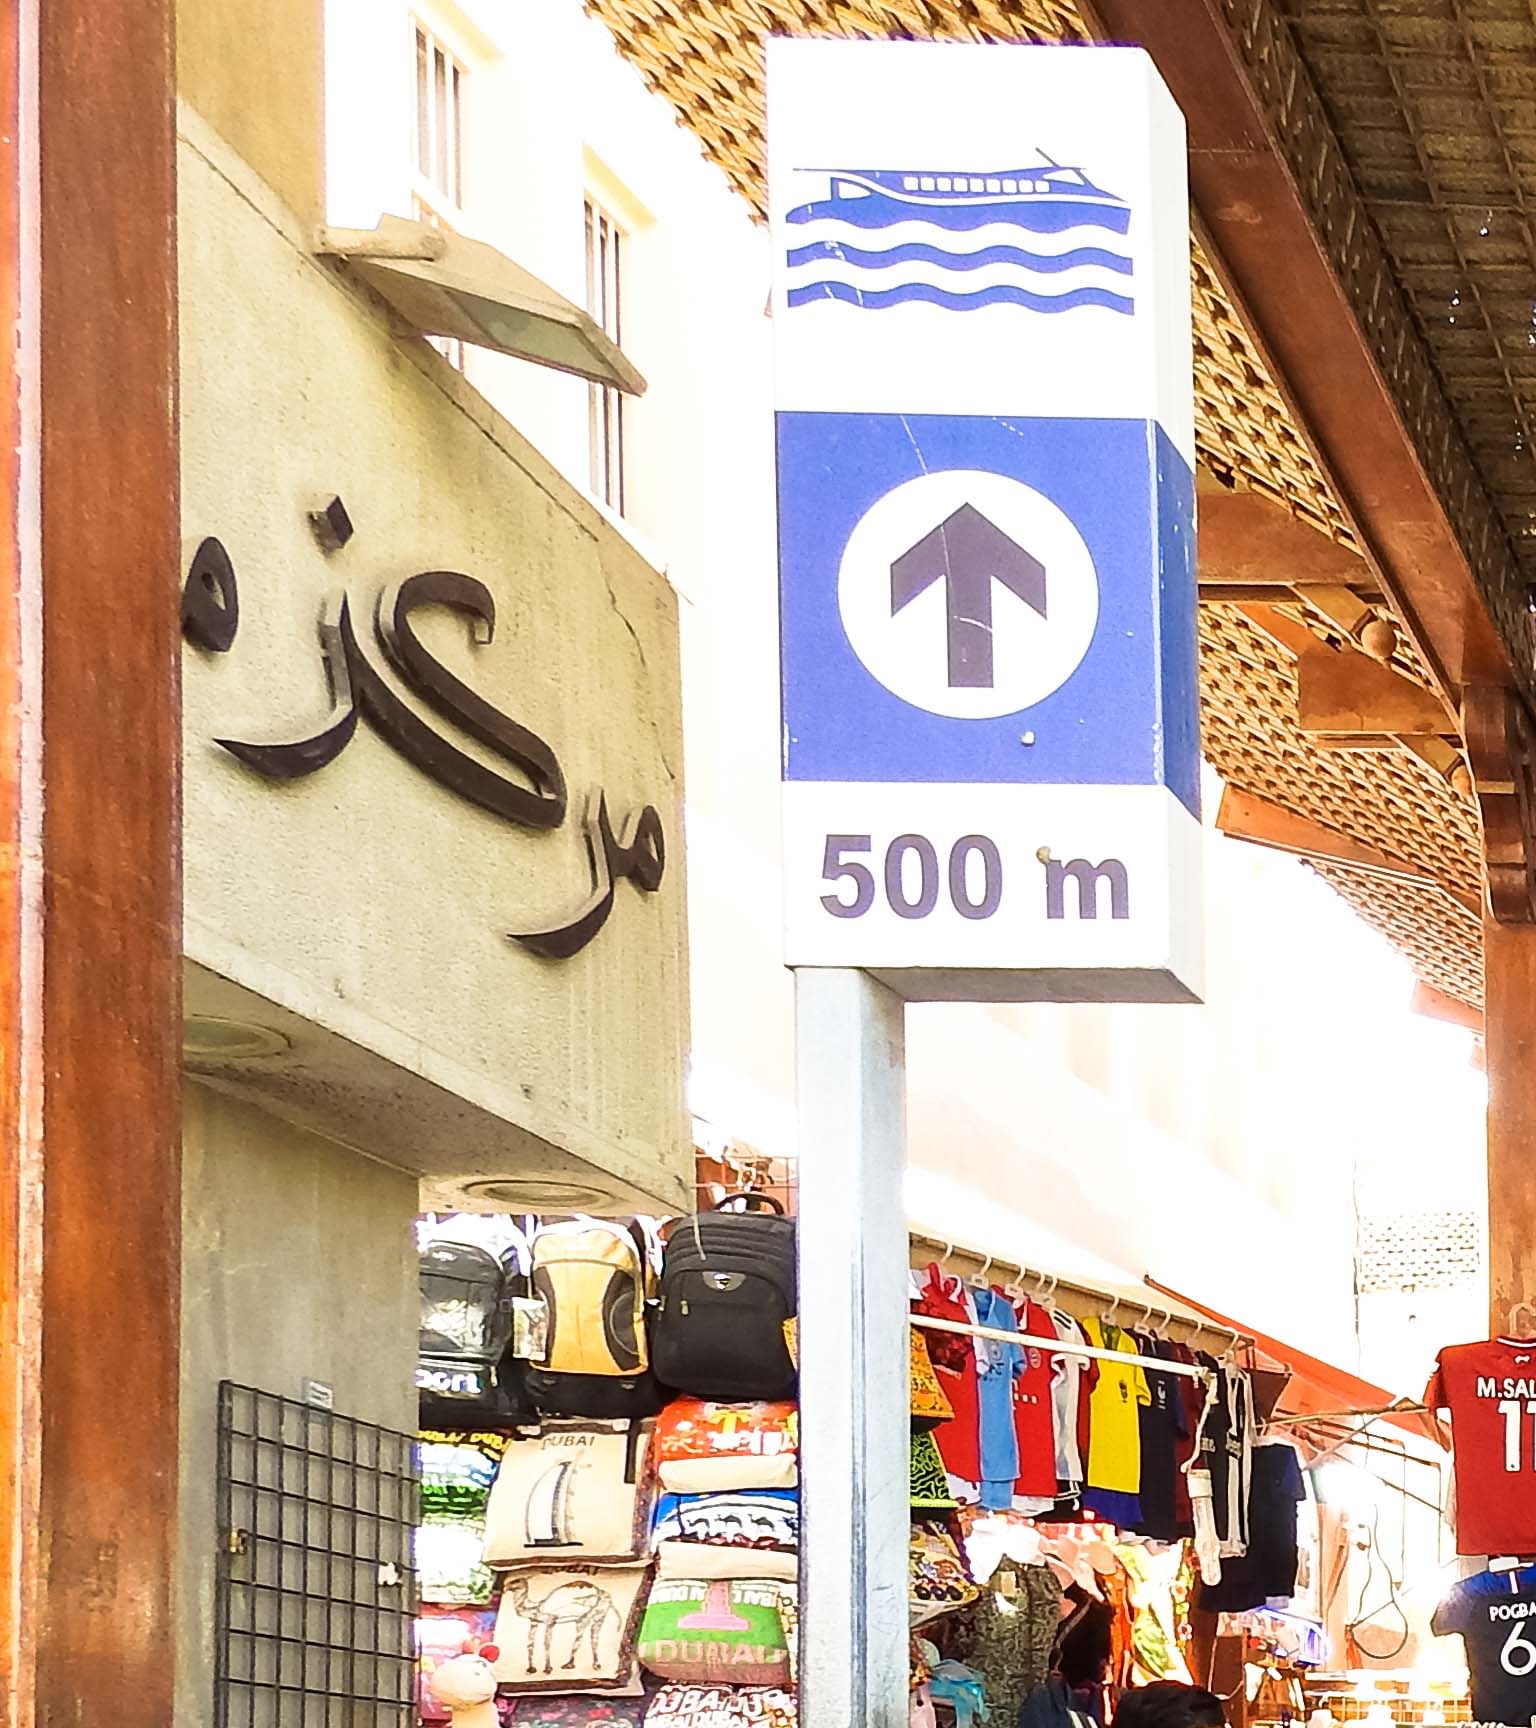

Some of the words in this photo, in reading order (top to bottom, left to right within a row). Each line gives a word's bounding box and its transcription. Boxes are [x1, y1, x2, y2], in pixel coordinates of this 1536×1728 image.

[212, 495, 664, 958] مركز
[820, 834, 1003, 920] 500
[1045, 858, 1129, 920] m
